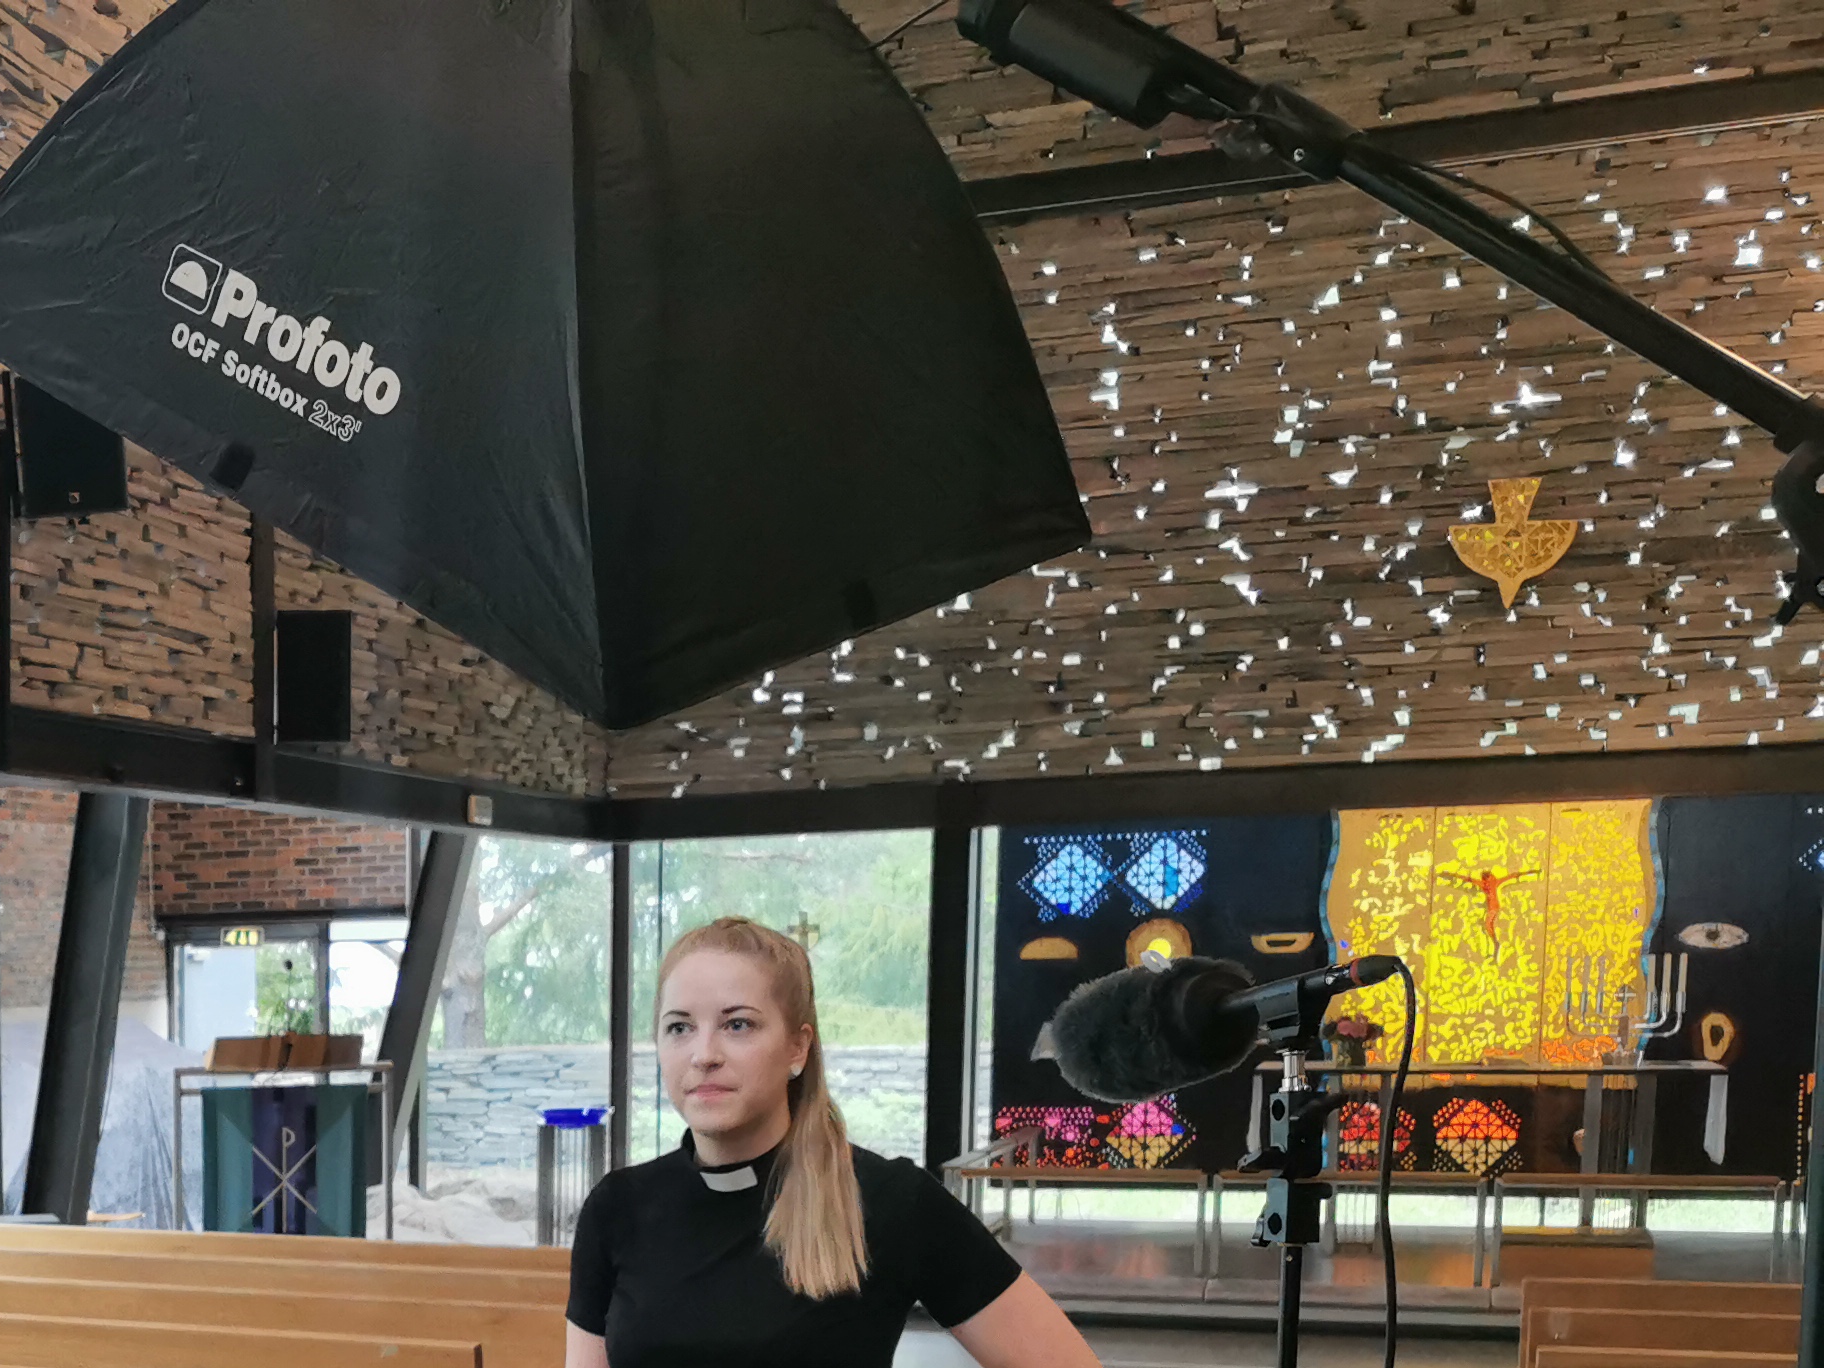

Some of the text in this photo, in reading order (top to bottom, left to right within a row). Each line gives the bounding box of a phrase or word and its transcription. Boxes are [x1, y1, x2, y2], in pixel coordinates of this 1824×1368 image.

[171, 322, 220, 363] OCF
[221, 350, 308, 417] Softbox
[211, 269, 401, 415] Profoto
